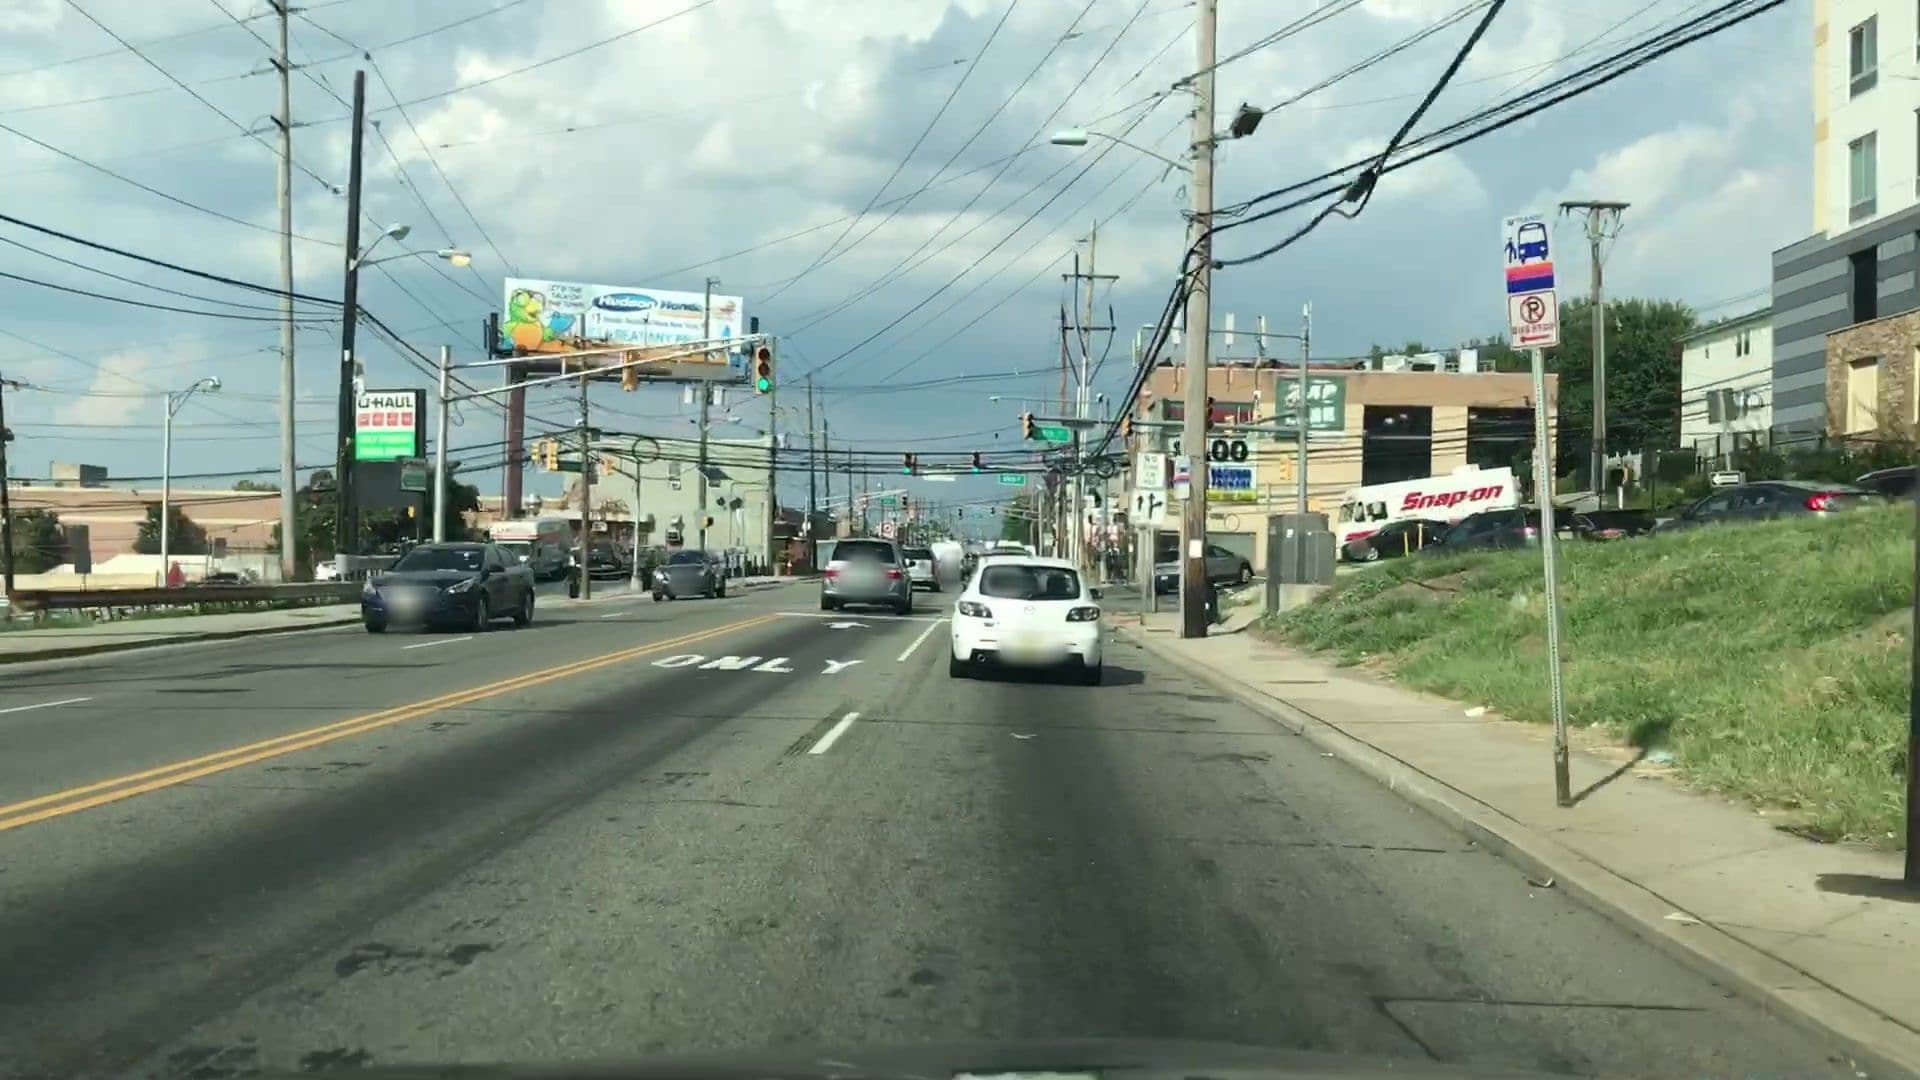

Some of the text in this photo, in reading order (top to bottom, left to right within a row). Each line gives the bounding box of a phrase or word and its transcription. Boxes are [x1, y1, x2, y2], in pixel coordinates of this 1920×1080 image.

[598, 295, 657, 311] Hudson
[358, 395, 413, 409] U-HAUL
[1401, 485, 1504, 512] Snap-on
[651, 654, 864, 674] ONLY
